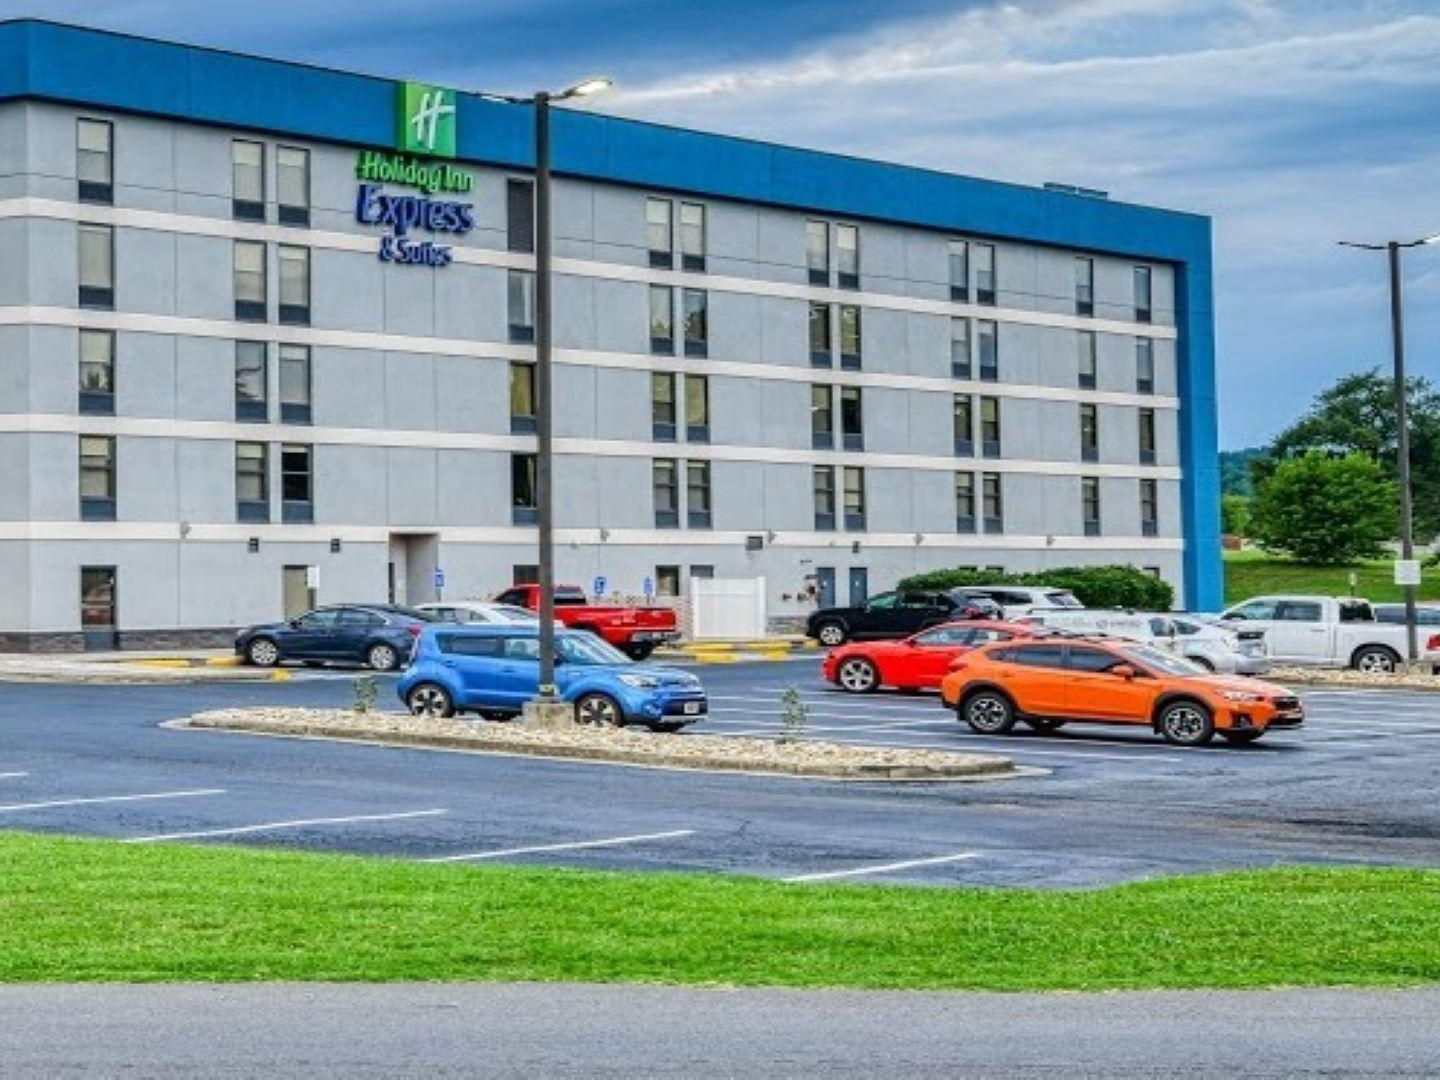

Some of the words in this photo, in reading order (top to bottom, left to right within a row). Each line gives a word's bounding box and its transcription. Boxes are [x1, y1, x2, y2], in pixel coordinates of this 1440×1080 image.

[357, 151, 443, 193] Holiday
[445, 163, 474, 193] Inn
[356, 184, 474, 235] Express
[378, 236, 396, 262] &
[397, 237, 453, 265] Suites
